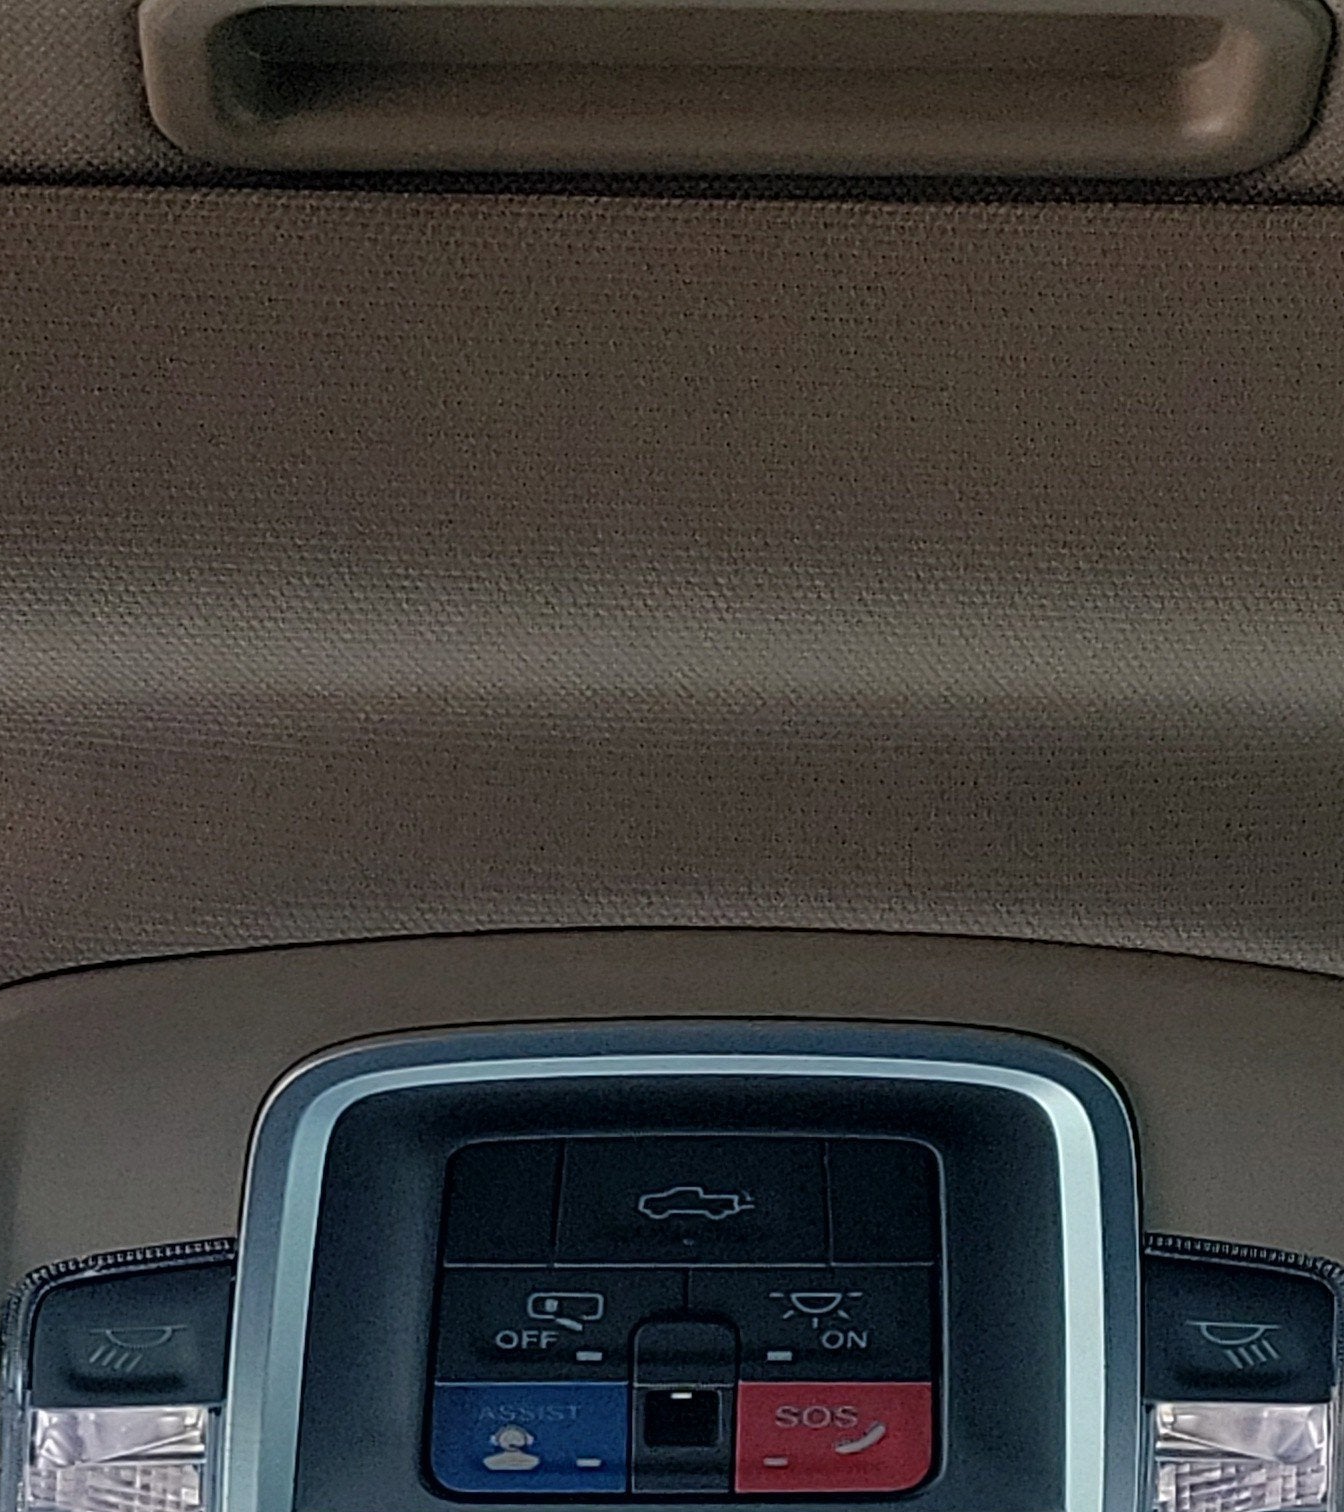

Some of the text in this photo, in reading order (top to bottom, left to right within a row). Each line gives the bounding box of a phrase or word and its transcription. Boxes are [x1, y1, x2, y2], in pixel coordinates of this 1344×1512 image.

[495, 1330, 558, 1350] OFF
[821, 1330, 869, 1350] ON
[478, 1405, 582, 1421] ASSIST
[775, 1405, 859, 1429] SOS
